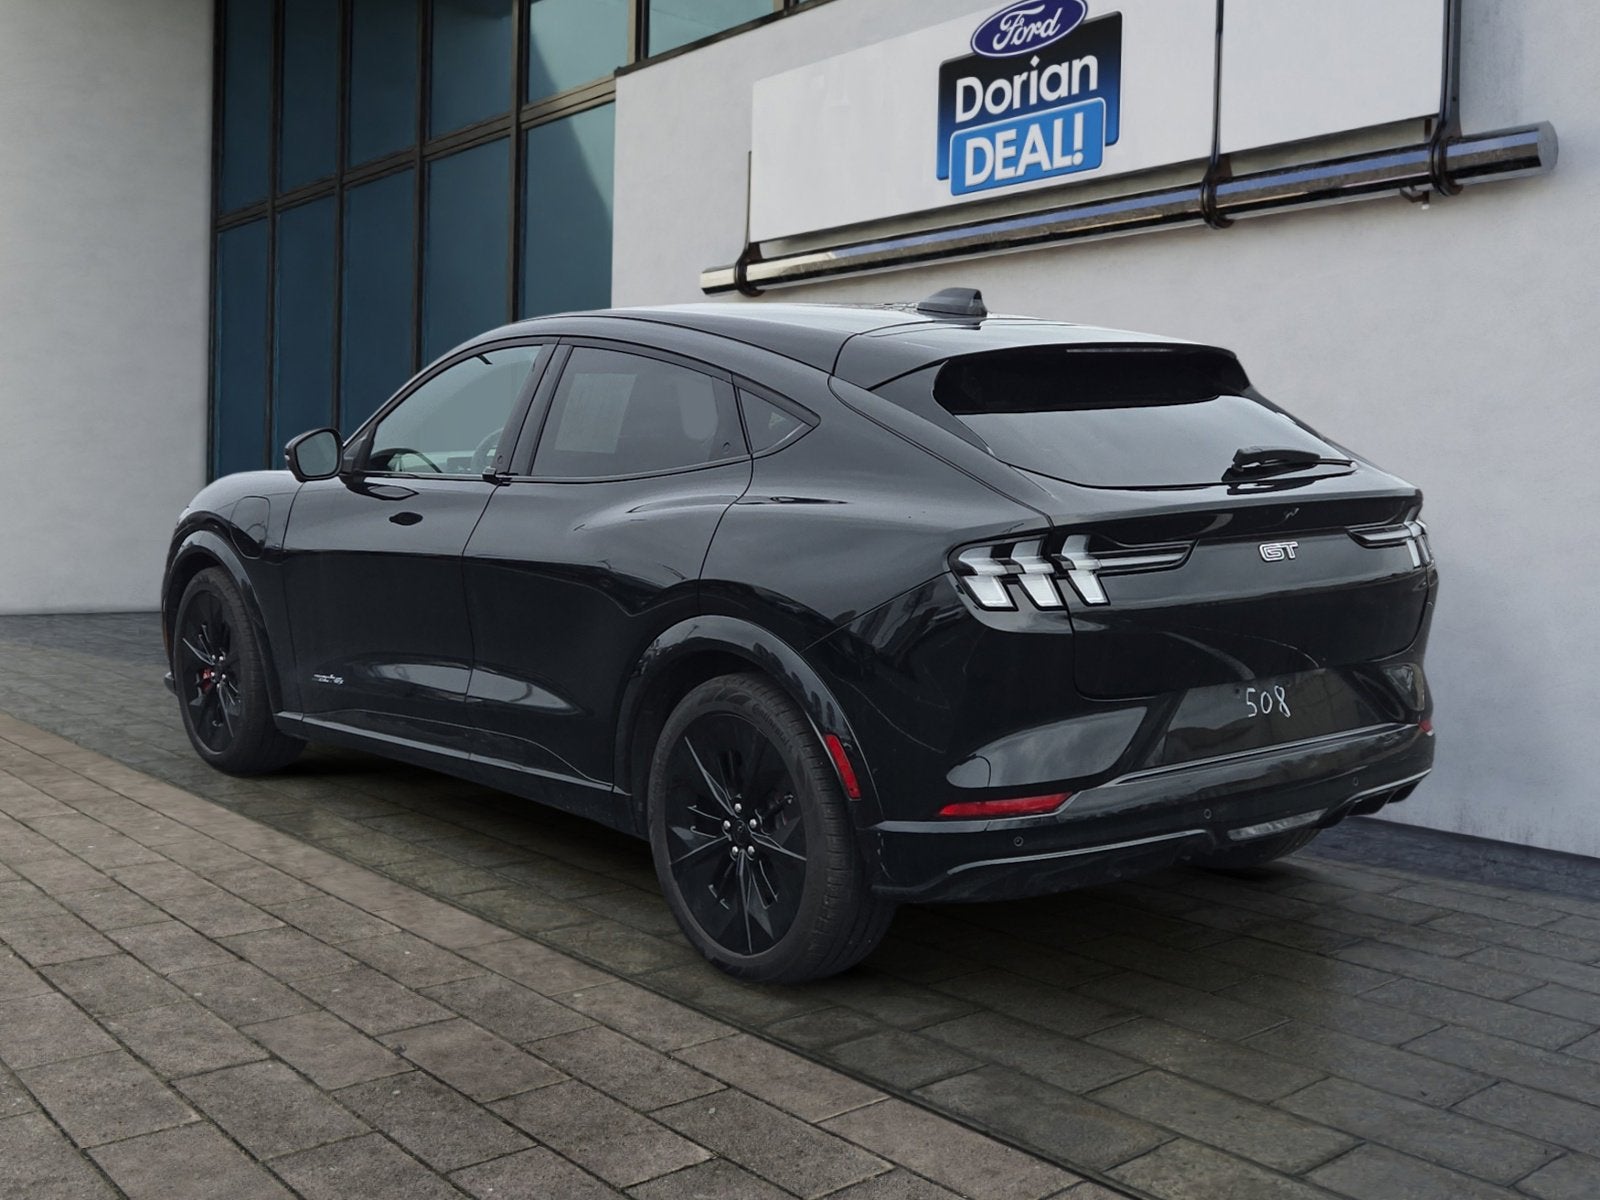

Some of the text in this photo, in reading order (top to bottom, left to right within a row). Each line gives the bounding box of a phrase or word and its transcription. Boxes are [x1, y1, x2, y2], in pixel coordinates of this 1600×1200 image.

[992, 4, 1064, 51] Ford
[955, 54, 1099, 124] Dorian
[964, 112, 1084, 187] DEAL!
[1258, 541, 1299, 562] GT
[1246, 685, 1291, 718] 508
